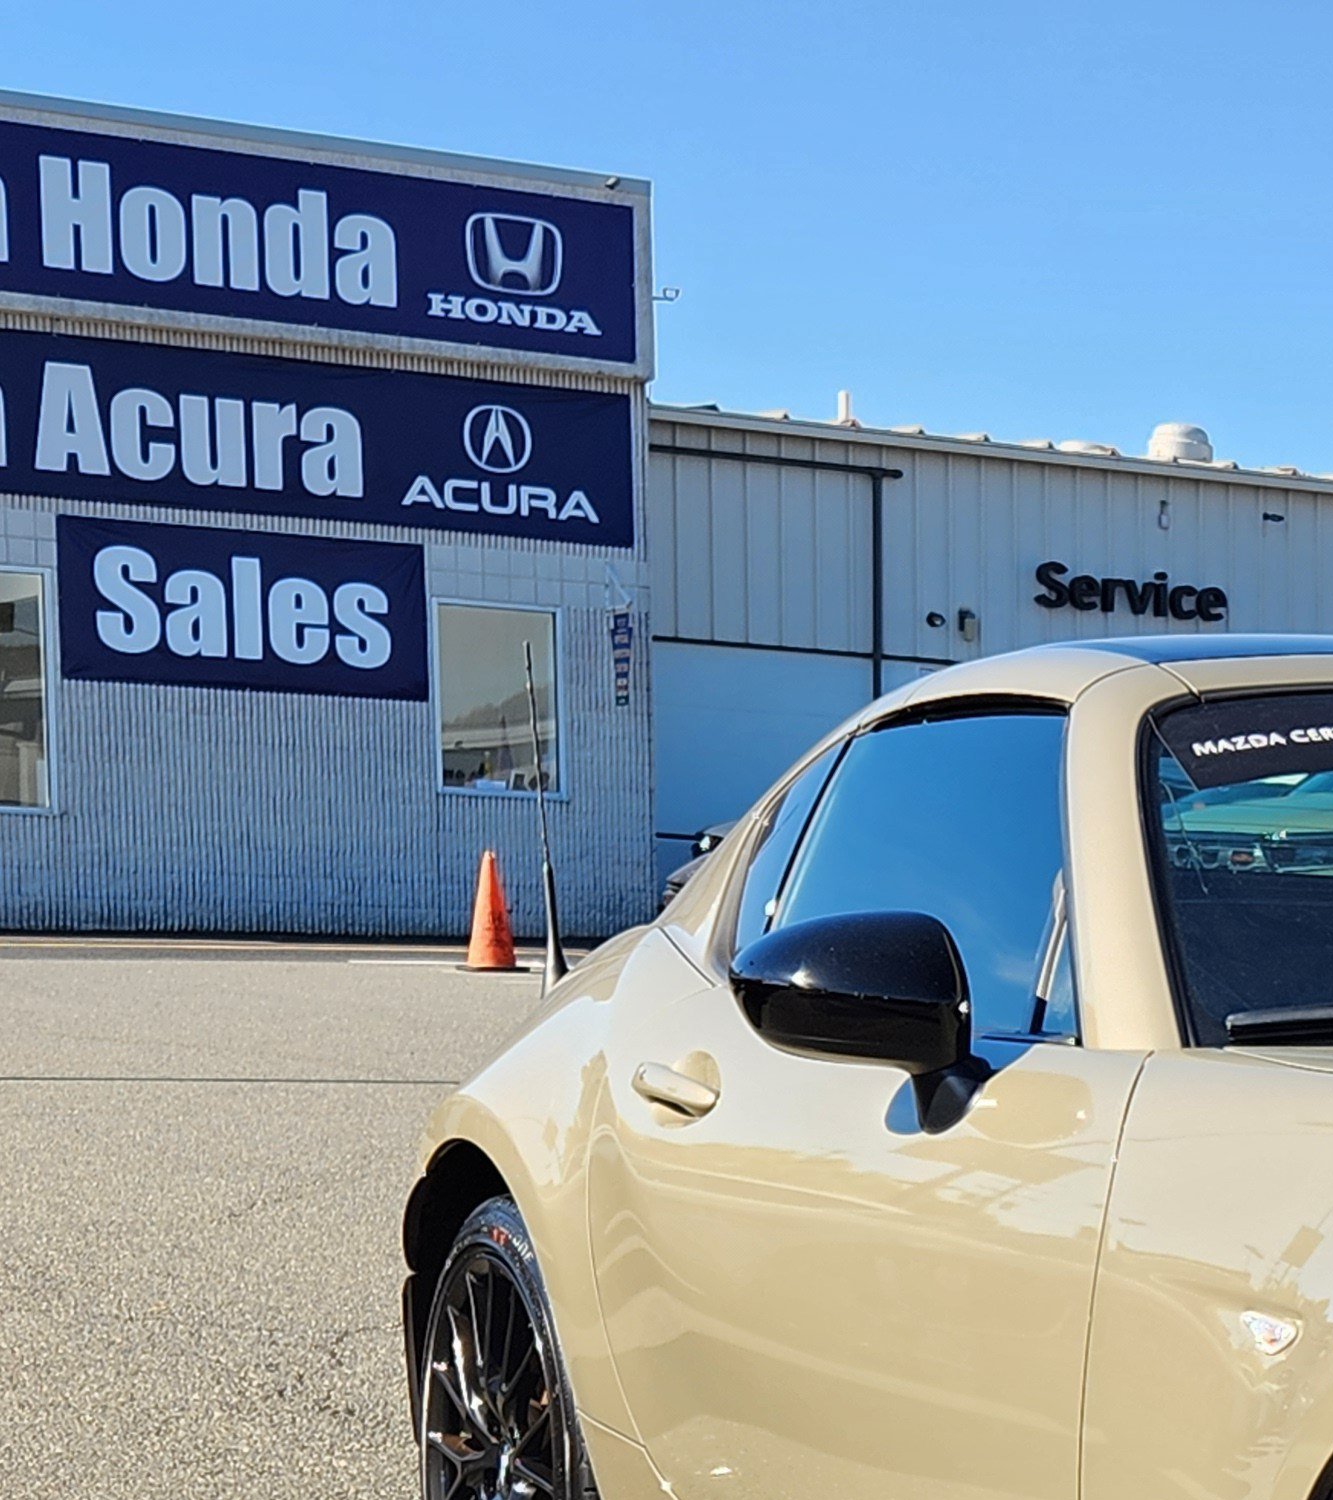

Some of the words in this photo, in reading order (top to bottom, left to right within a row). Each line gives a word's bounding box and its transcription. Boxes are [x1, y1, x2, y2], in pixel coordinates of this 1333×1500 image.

[39, 154, 398, 308] Honda
[427, 292, 602, 336] HONDA
[34, 361, 364, 498] Acura
[401, 475, 600, 523] ACURA
[93, 545, 392, 670] Sales
[1034, 561, 1228, 621] Service
[1192, 732, 1287, 756] MAZDA
